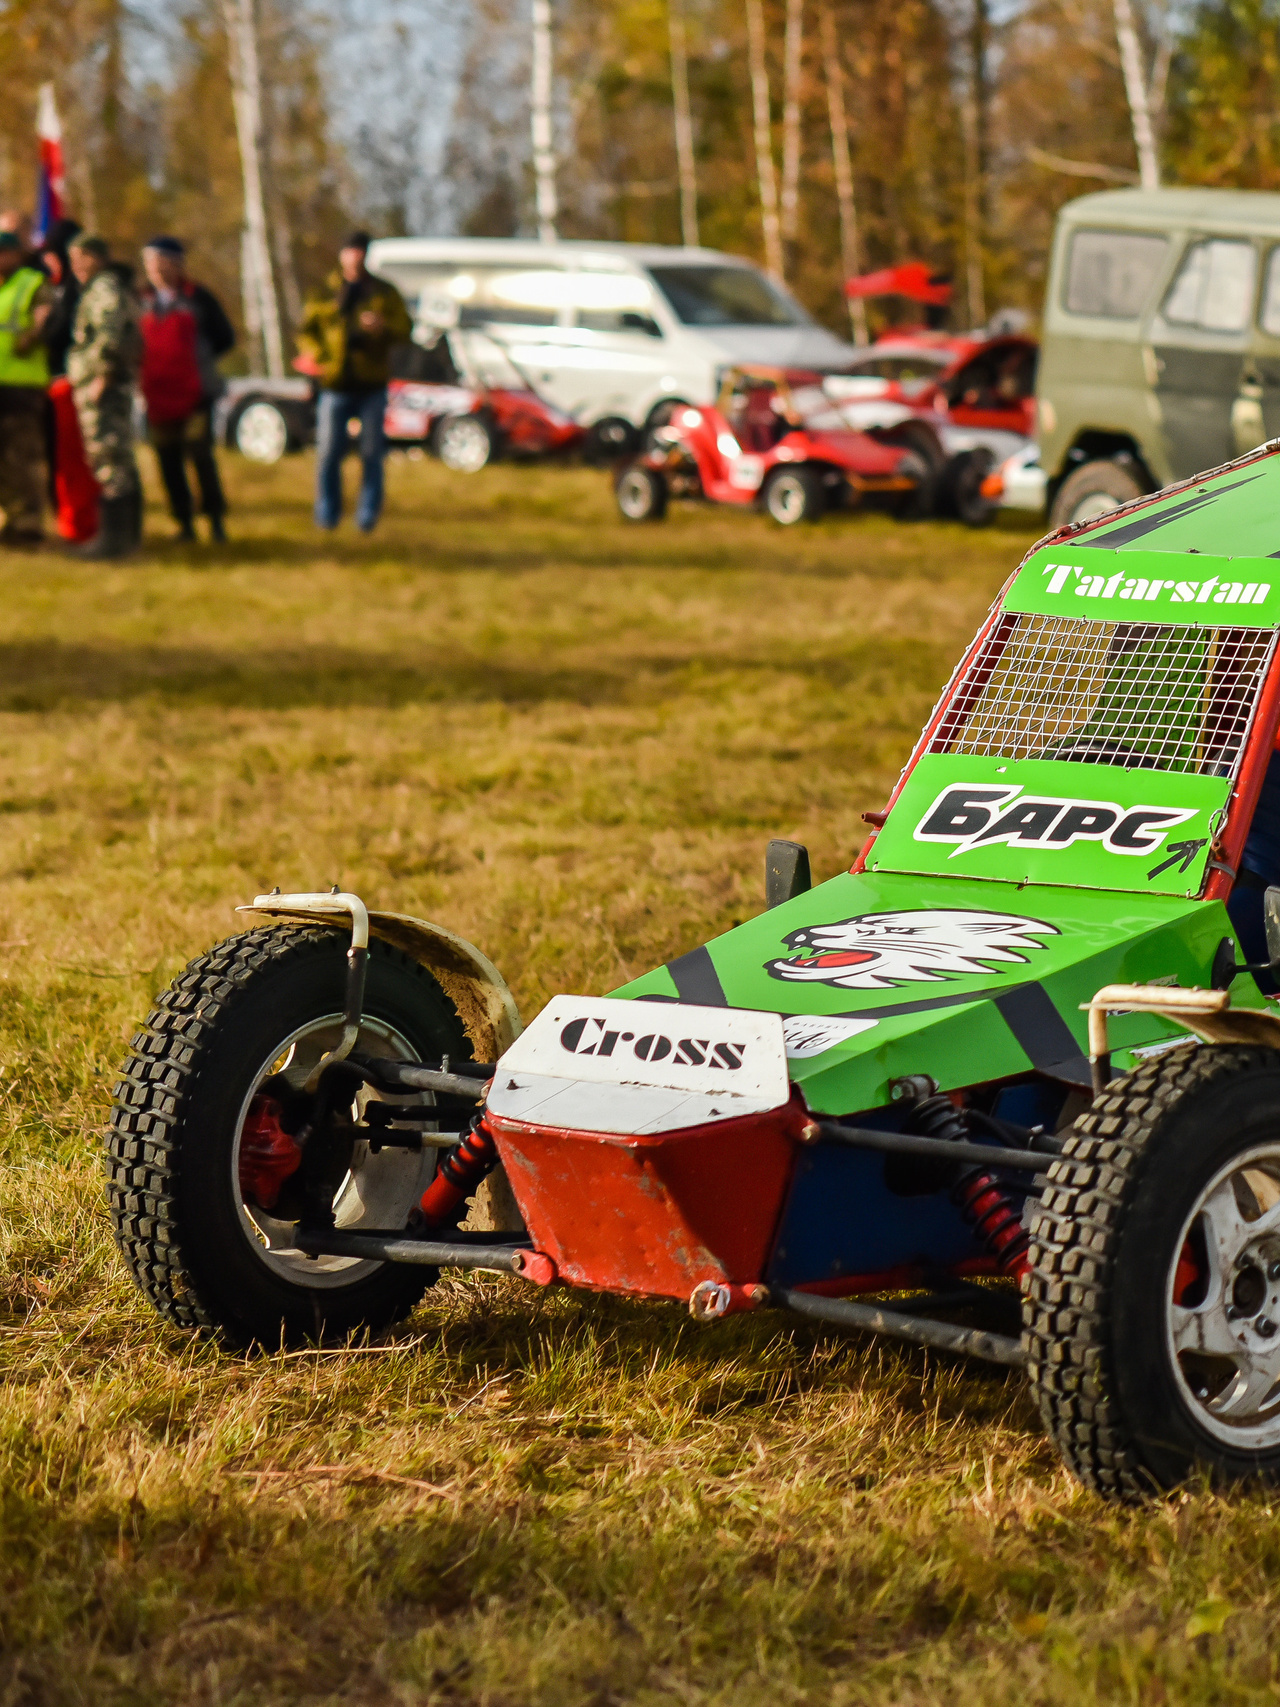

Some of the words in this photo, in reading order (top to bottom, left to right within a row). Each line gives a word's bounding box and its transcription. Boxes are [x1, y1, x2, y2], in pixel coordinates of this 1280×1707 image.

[1041, 562, 1272, 604] Tatarstan
[915, 784, 1198, 857] БАРС
[560, 1016, 747, 1071] Cross
